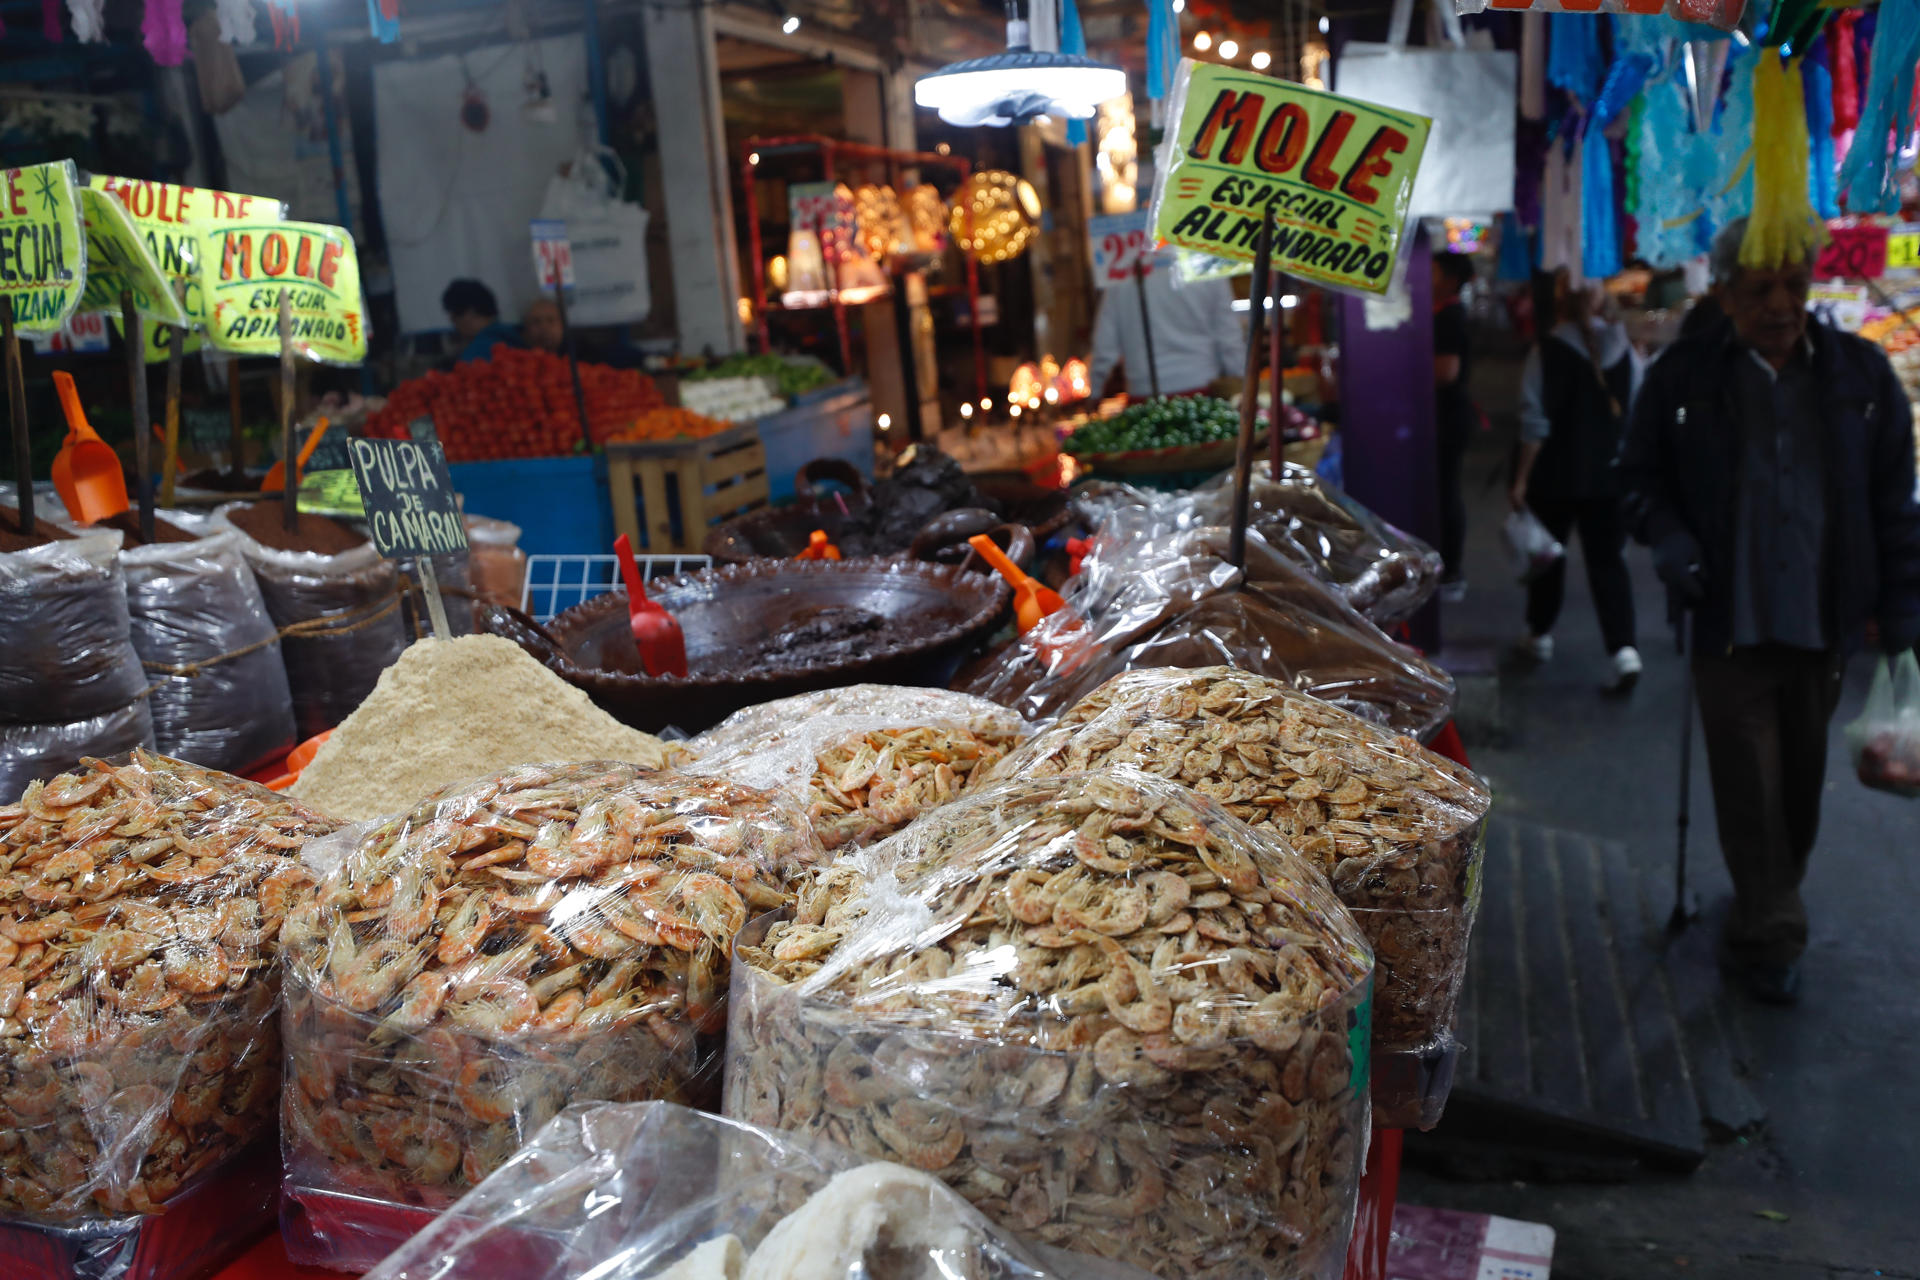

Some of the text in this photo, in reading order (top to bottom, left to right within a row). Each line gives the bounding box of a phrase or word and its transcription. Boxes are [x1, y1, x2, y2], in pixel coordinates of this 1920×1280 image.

[1188, 89, 1408, 205] MOLE
[0, 168, 28, 219] E
[1211, 175, 1346, 230] ESPECIAL
[220, 231, 344, 289] MOLE
[354, 439, 439, 493] PULPA
[396, 492, 424, 513] DE
[374, 510, 468, 553] CAMARON
